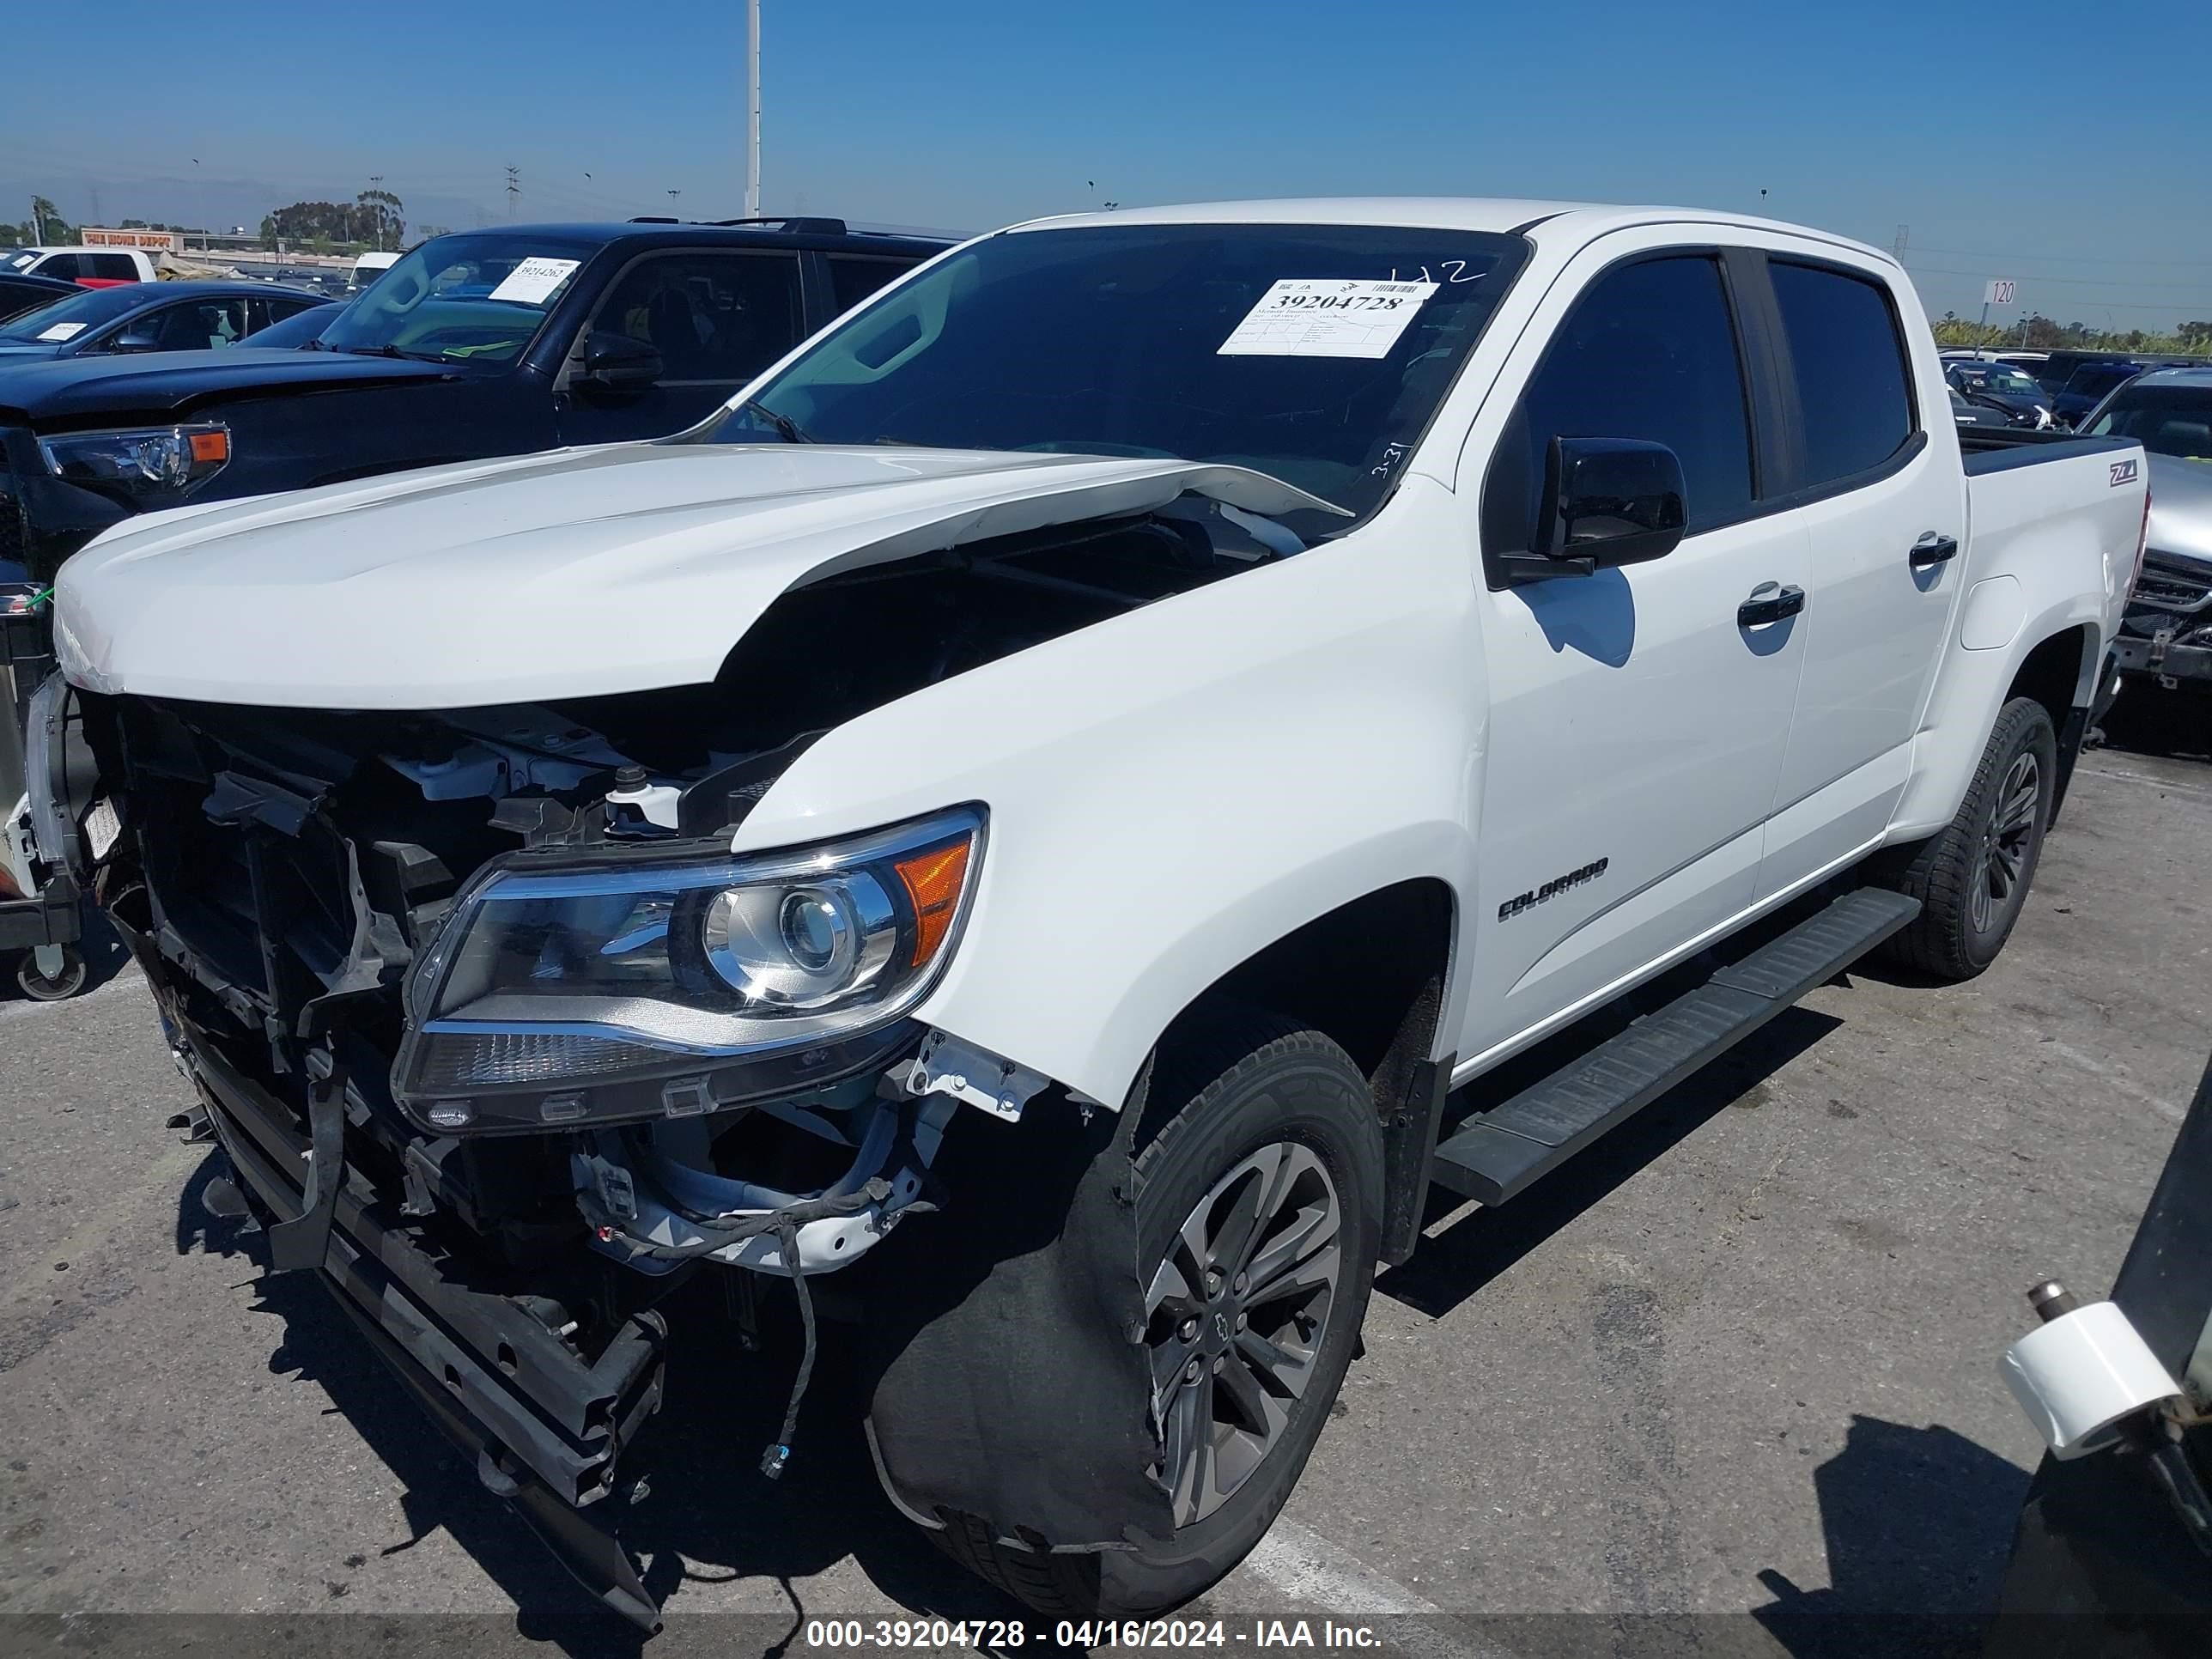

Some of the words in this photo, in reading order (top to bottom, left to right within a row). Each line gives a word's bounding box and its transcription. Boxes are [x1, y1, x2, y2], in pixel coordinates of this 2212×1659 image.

[139, 236, 171, 248] DEPOT
[1270, 295, 1404, 310] 39204728
[1993, 282, 2014, 303] 120
[2110, 459, 2138, 489] Z71
[1498, 856, 1609, 919] COLORADO
